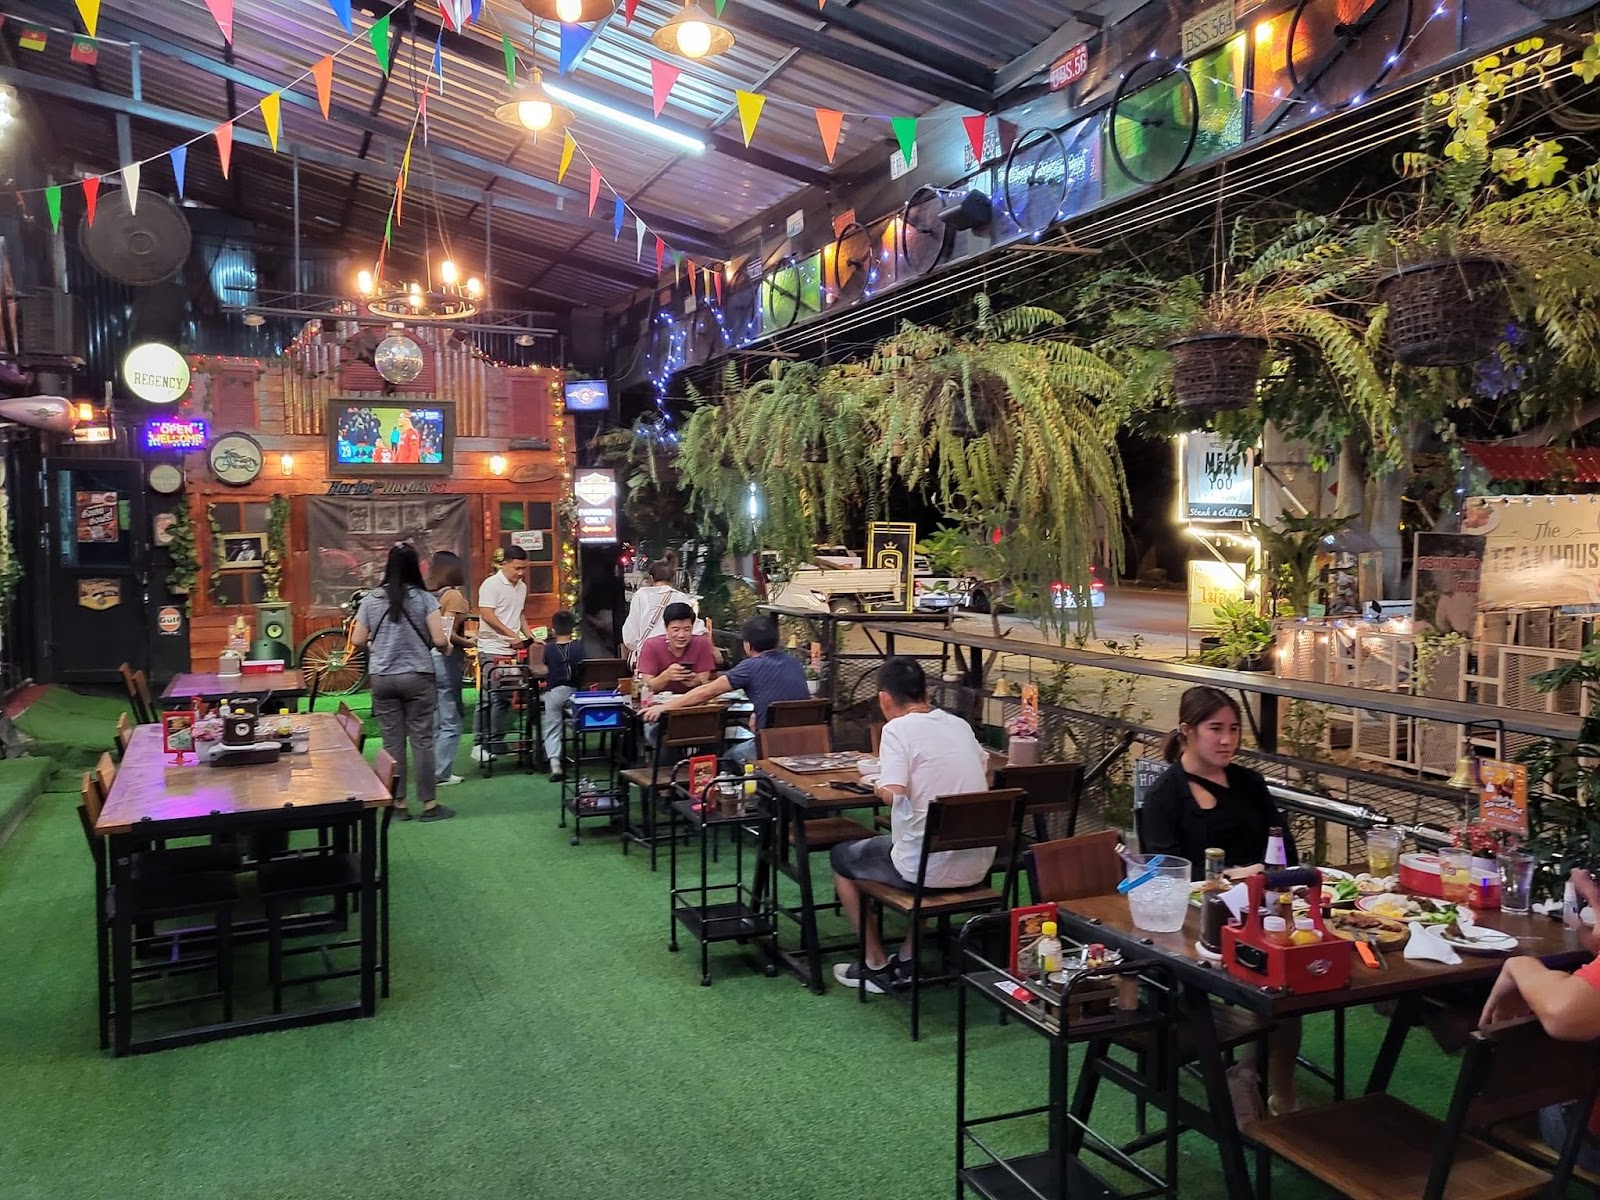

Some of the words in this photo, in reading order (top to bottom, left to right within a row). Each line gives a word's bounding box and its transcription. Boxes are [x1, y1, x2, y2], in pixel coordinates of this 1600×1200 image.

[133, 371, 184, 390] REGENCY
[160, 423, 190, 434] OPEN
[1208, 478, 1233, 490] YOU
[1188, 506, 1211, 517] Steak
[1534, 520, 1561, 541] The
[159, 615, 182, 624] Gulf
